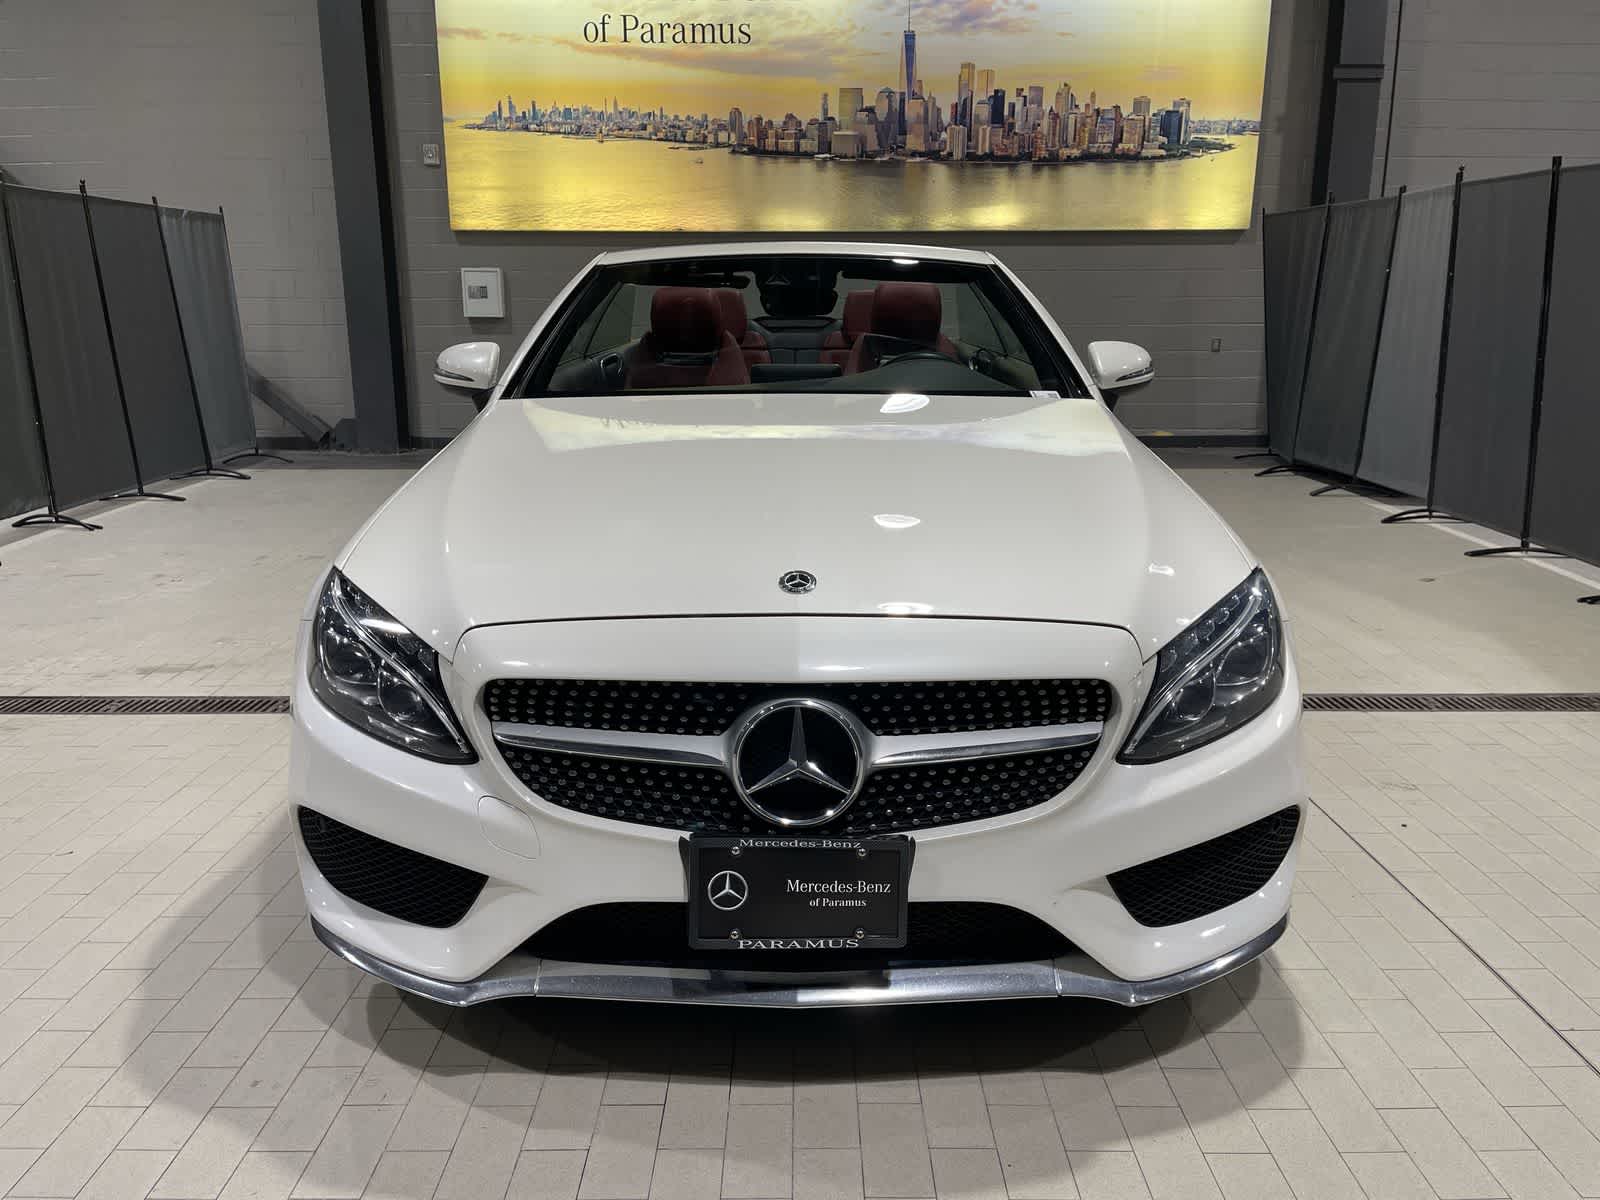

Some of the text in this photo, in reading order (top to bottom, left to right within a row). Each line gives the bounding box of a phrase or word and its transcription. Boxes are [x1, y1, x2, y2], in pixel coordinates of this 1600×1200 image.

[584, 14, 751, 44] of Paramus
[739, 838, 862, 849] Mercedes-Benz
[786, 879, 891, 894] Mercedes-Benz
[809, 897, 867, 907] of Paramus
[738, 939, 860, 949] PARAMUS
